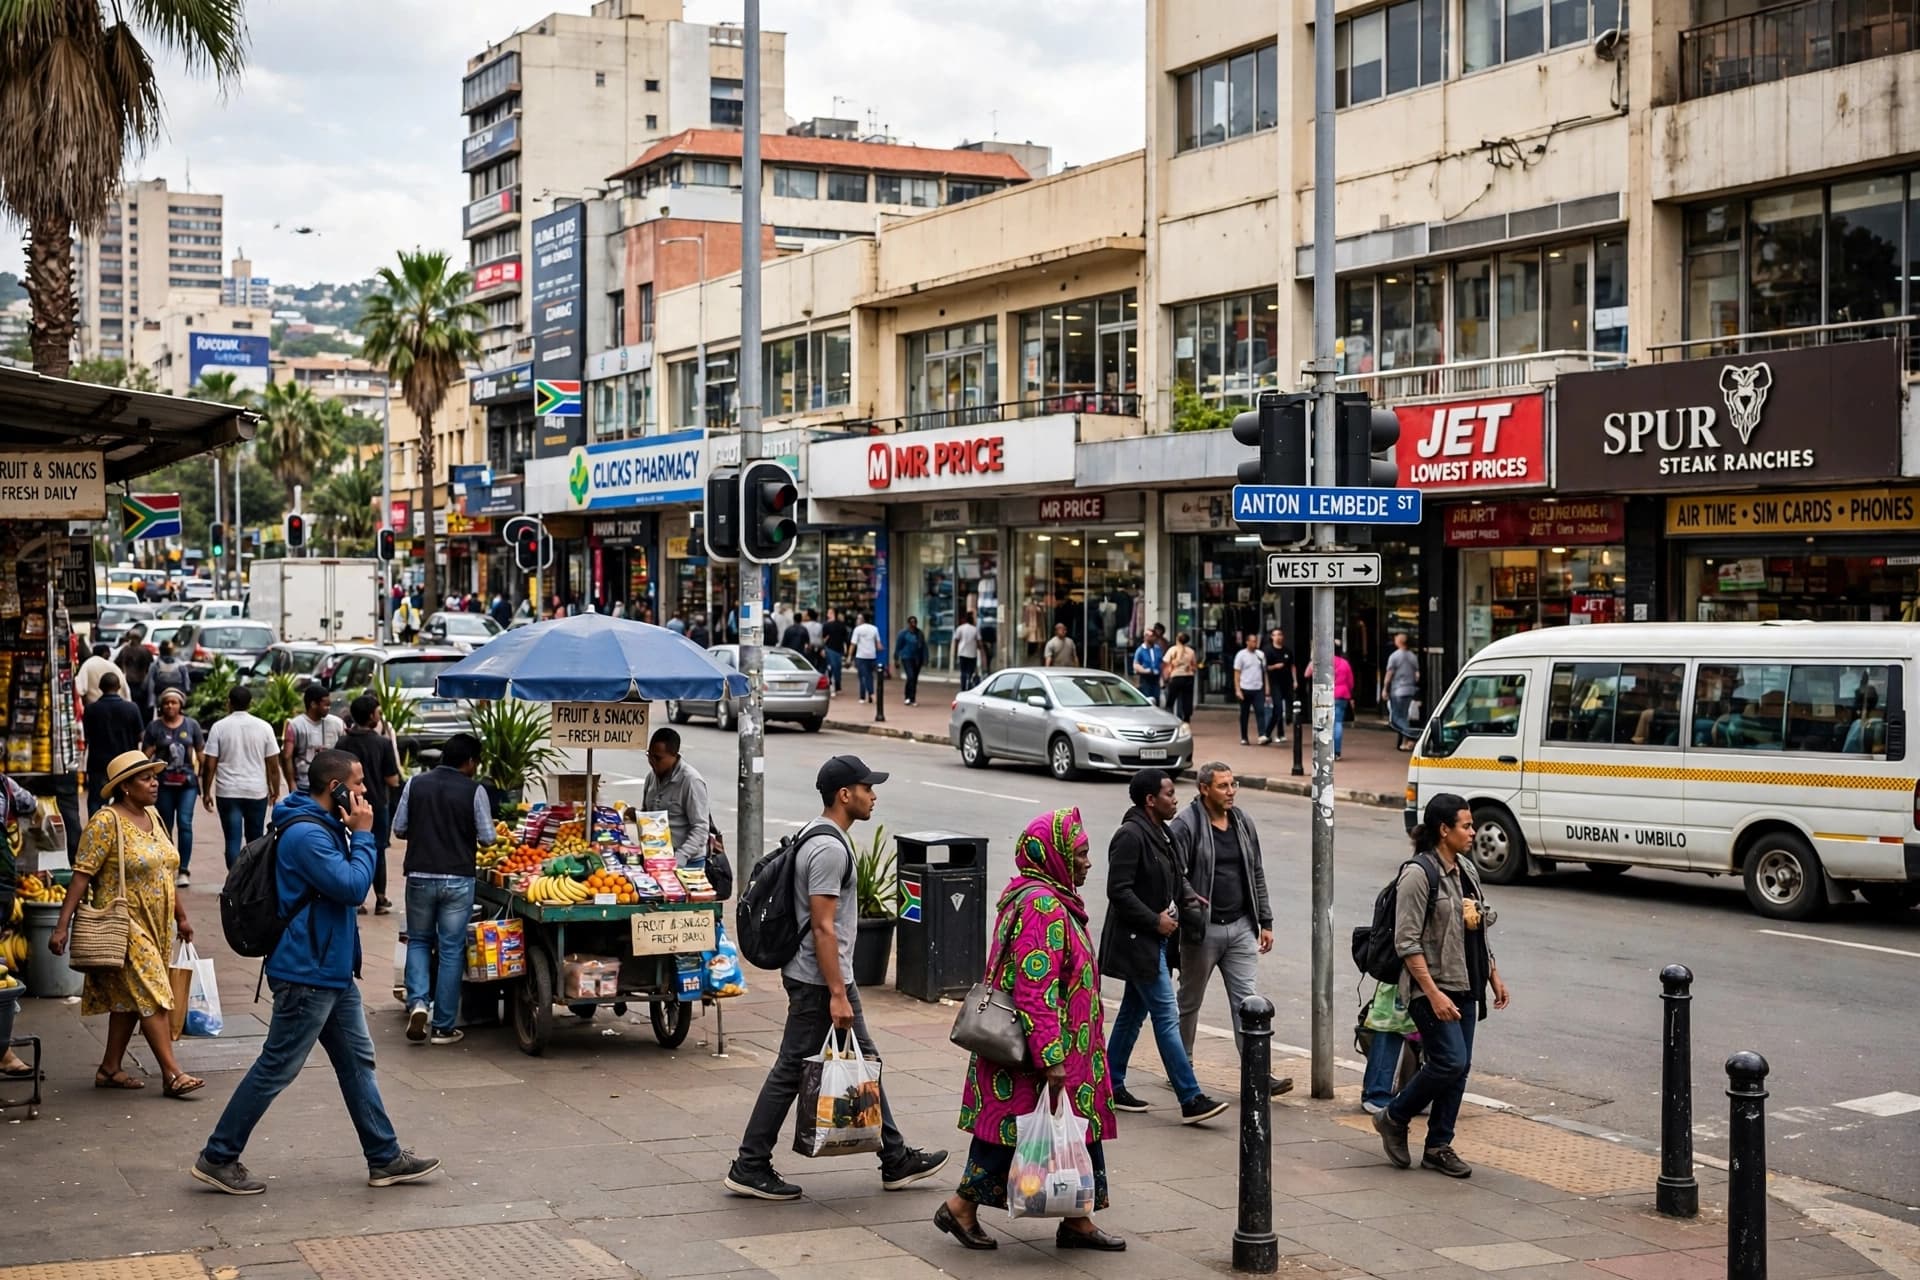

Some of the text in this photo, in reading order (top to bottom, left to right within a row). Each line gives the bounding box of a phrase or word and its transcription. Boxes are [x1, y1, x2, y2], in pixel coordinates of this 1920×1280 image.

[1417, 402, 1513, 459] JET
[1603, 405, 1722, 455] SPUR
[593, 459, 632, 489] CLICKS
[634, 449, 700, 485] PHARMACY
[894, 445, 930, 479] MR
[934, 436, 1004, 476] PRICE
[1410, 456, 1528, 483] LOWEST PRICES
[1658, 448, 1815, 475] STEAK RANCHES
[32, 460, 43, 480] &
[48, 460, 97, 480] SNACKS
[1, 486, 78, 501] FRESH DAILY
[1240, 493, 1300, 515] ANTON
[1309, 494, 1390, 517] LEMBEDE
[1397, 495, 1414, 511] ST
[1041, 498, 1101, 519] MR PRICE
[1676, 504, 1700, 527] AIR
[1703, 503, 1737, 526] TIME
[1752, 501, 1778, 525] SIM
[1782, 499, 1833, 524] CARDS
[1850, 496, 1914, 522] PHONES
[1276, 562, 1345, 579] WEST ST
[1581, 598, 1606, 612] JET
[557, 707, 646, 726] FRUIT & SNACKS
[603, 730, 633, 744] DAILY
[1566, 825, 1619, 843] DURBAN
[1635, 829, 1687, 849] UMBILO
